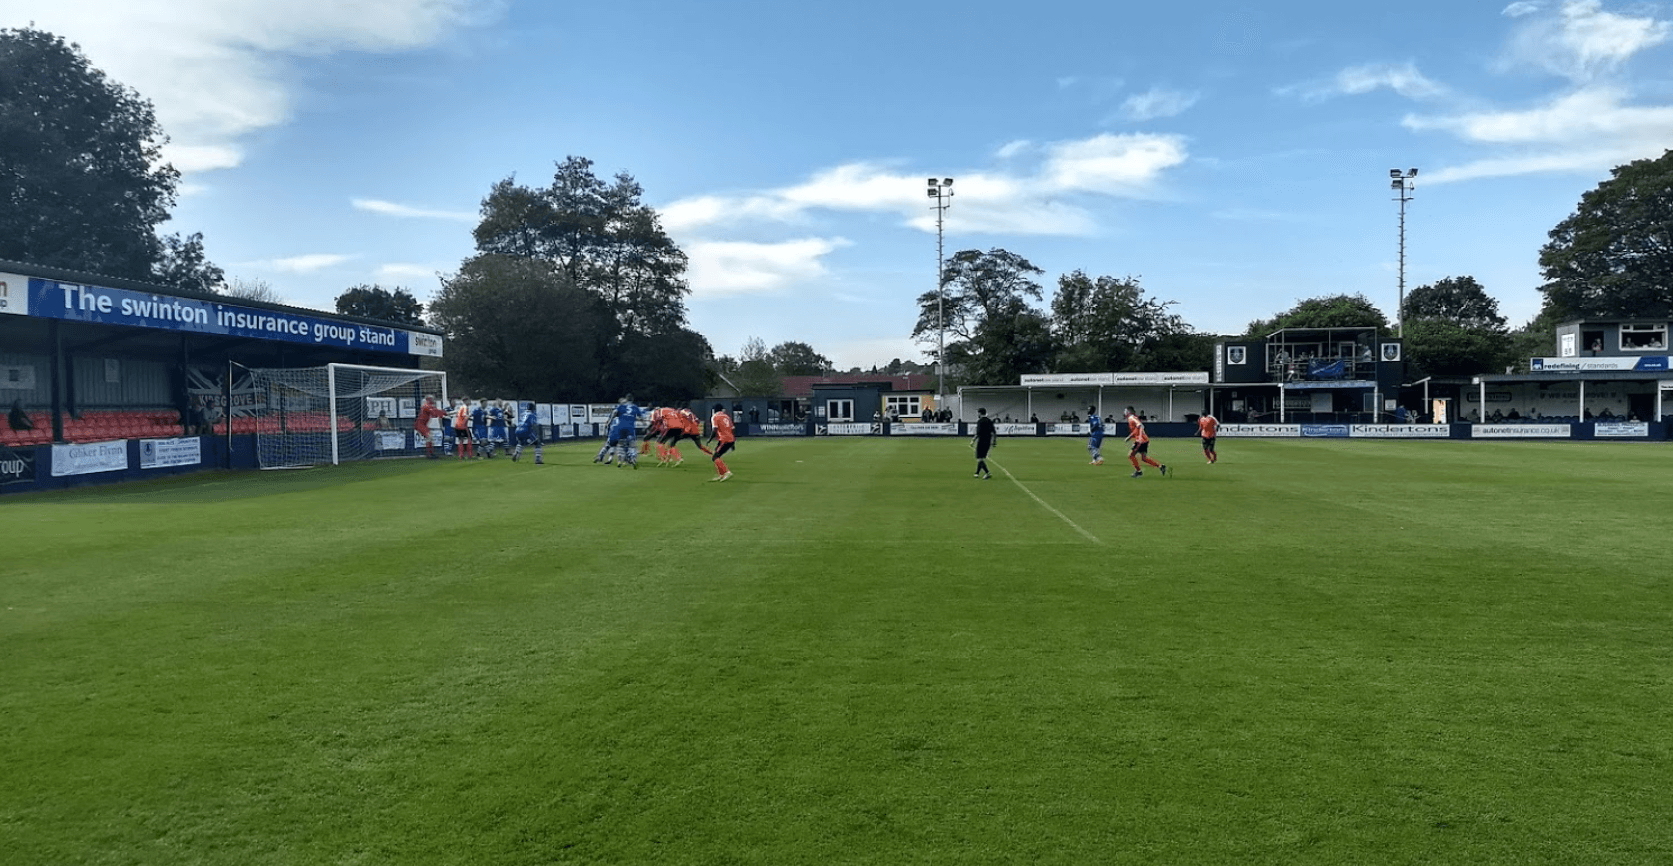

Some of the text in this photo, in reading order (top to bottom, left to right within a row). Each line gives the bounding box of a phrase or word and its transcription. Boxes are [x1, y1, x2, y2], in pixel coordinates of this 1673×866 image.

[58, 284, 396, 346] The swinton insurance group stand
[1544, 362, 1580, 370] redefining
[198, 394, 253, 407] KISGOVE
[1216, 424, 1299, 433] ndertons
[1352, 425, 1449, 433] Kindertons
[0, 459, 25, 478] oup
